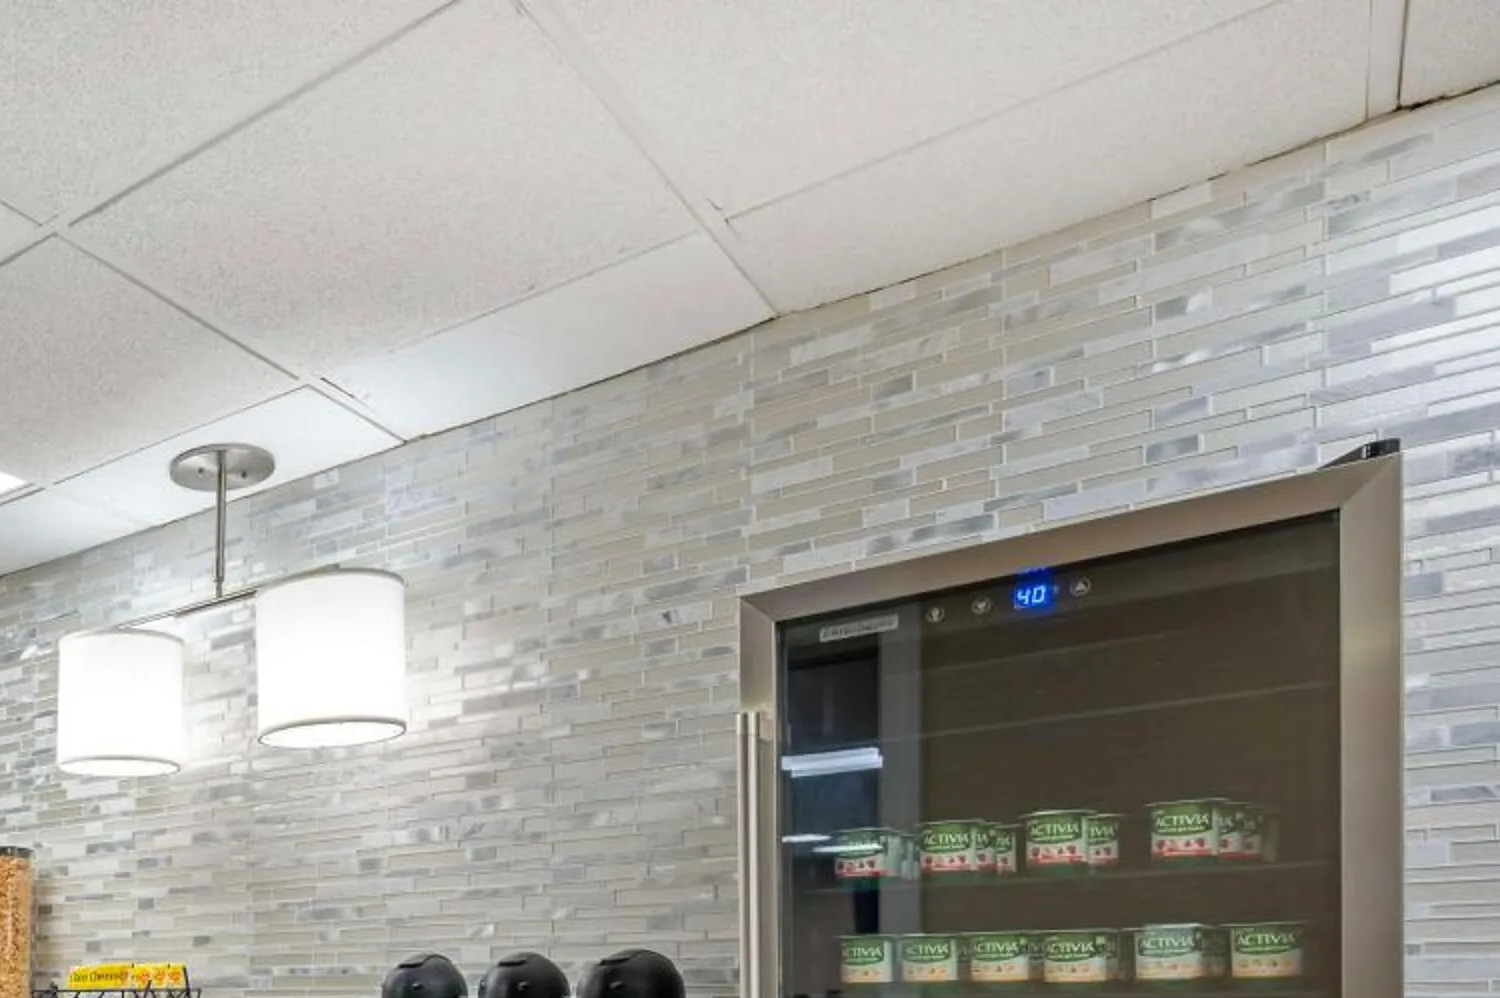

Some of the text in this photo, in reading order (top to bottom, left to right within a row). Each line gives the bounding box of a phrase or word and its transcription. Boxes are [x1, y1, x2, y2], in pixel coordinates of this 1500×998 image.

[1016, 584, 1046, 604] 40
[1155, 814, 1209, 827] ACTIVIA
[1030, 823, 1079, 836] ACTIVIA
[923, 833, 970, 845] ACTIVIA
[1141, 937, 1195, 948] ACTIVIA
[1237, 933, 1300, 945] ACTIVIA
[1047, 943, 1094, 953] ACTIVIA
